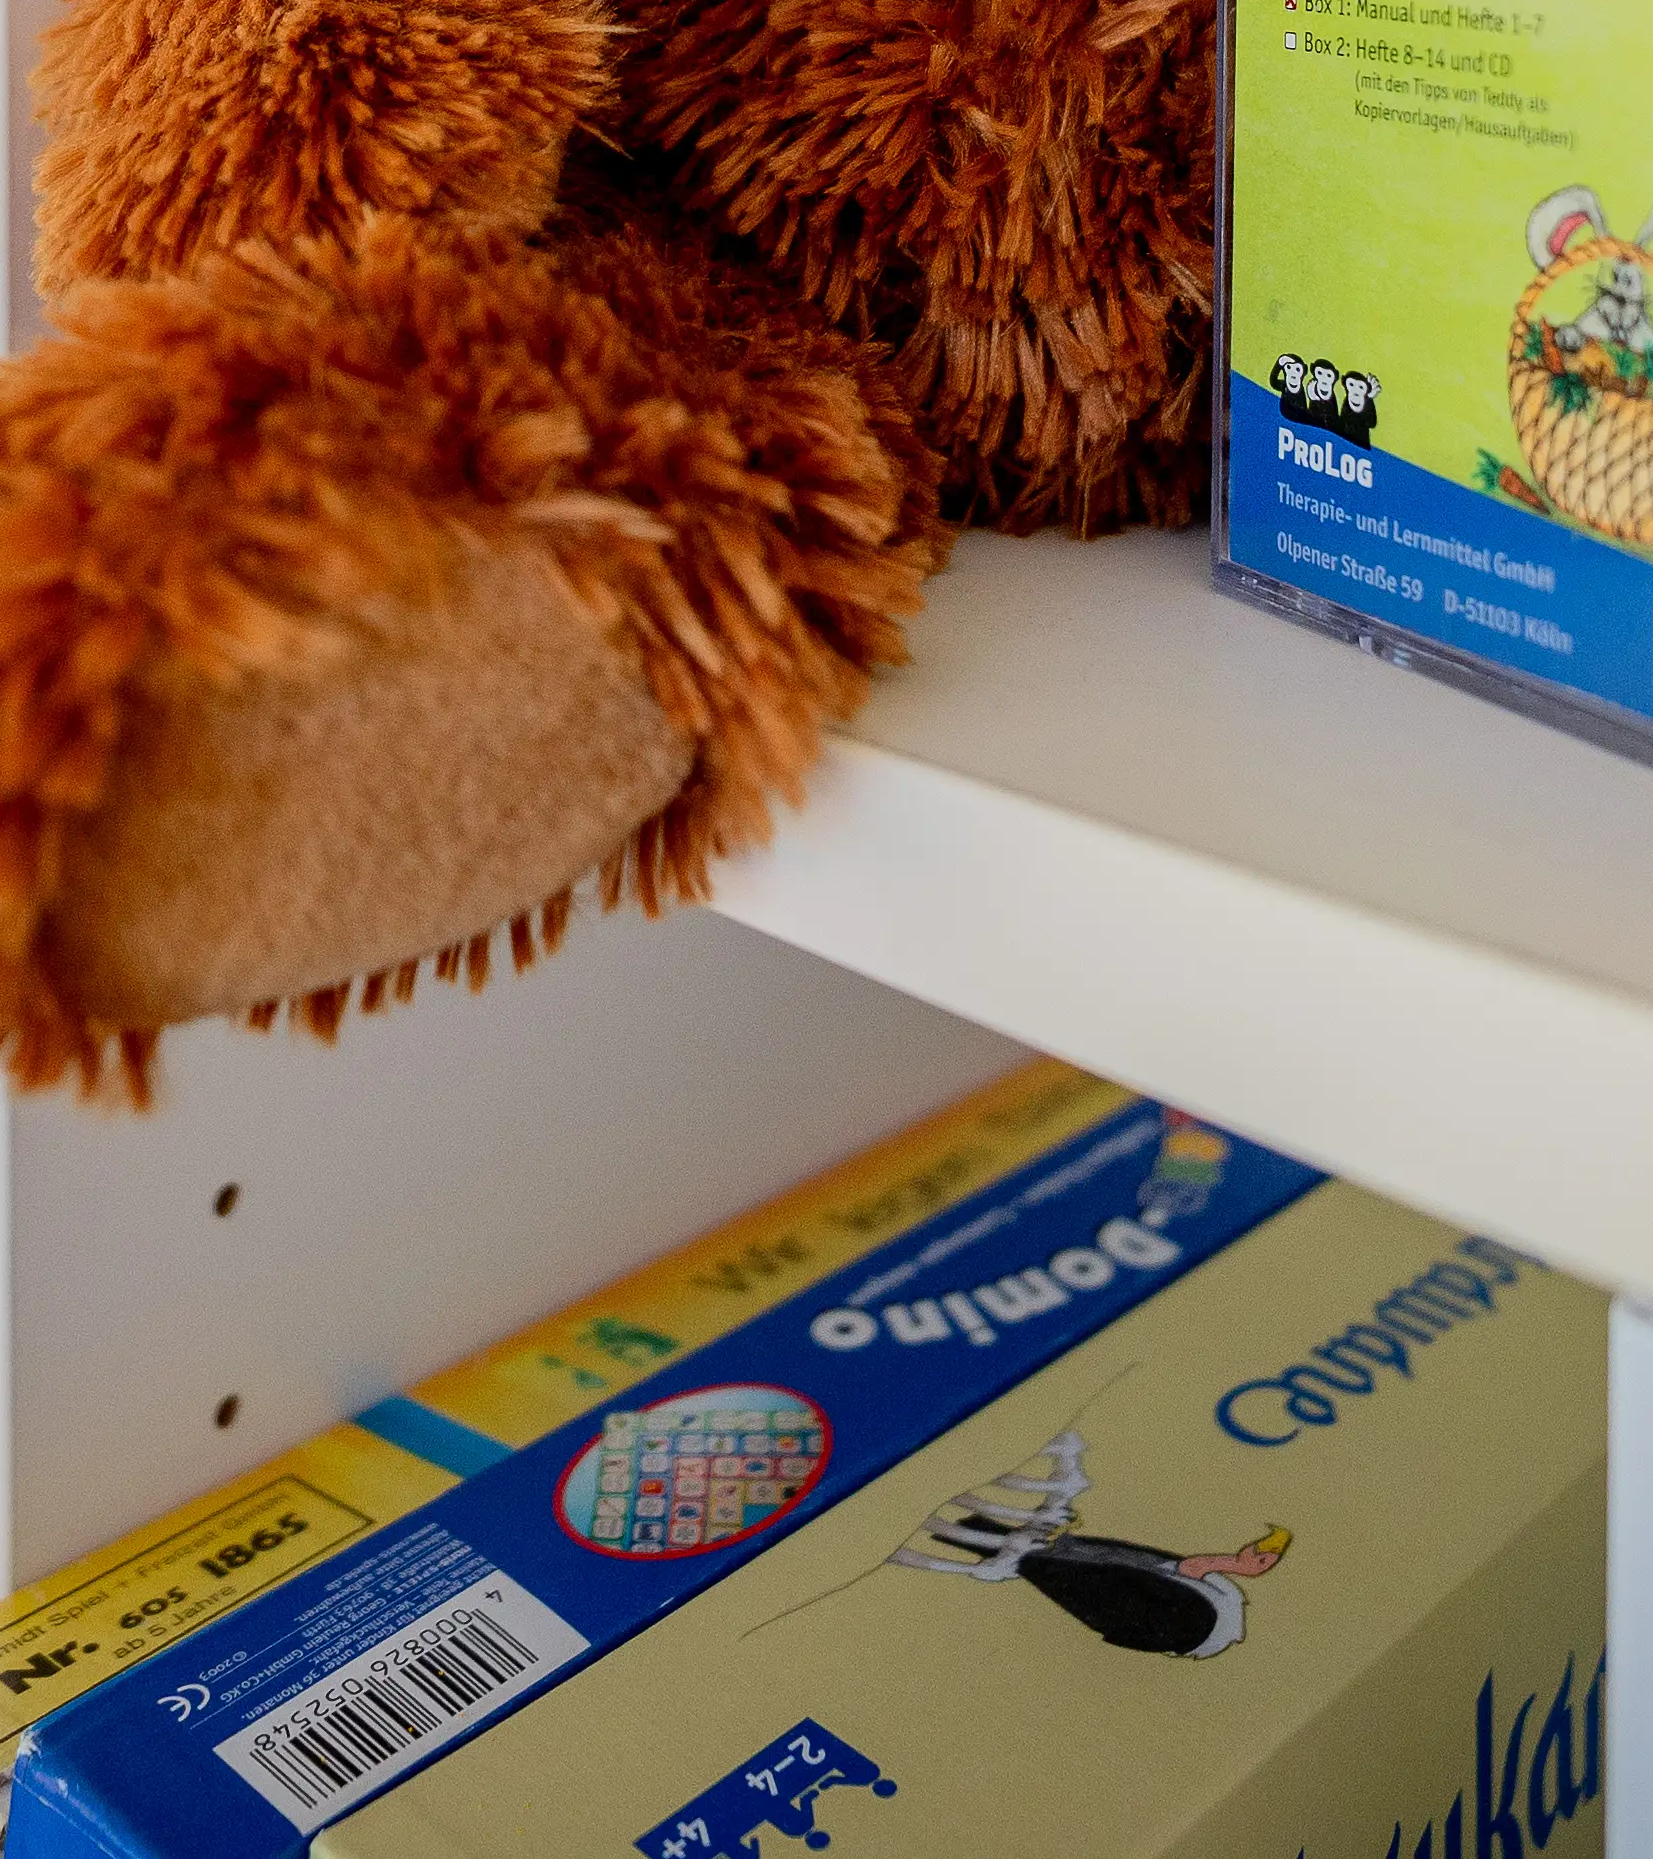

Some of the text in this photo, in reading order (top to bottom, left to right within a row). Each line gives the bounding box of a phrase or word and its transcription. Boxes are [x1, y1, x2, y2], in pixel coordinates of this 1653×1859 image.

[1420, 4, 1451, 28] und
[1457, 6, 1505, 35] Hefte
[1304, 31, 1332, 56] Box
[1336, 36, 1351, 58] 2:
[1356, 38, 1399, 64] Hefte
[1450, 52, 1485, 76] und
[1488, 53, 1513, 78] CD
[1354, 69, 1382, 93] (mit
[1385, 72, 1410, 94] den
[1413, 77, 1449, 102] Tipps
[1452, 87, 1478, 105] von
[1277, 481, 1556, 595] Therapie- und Lernmittel GmbH
[1277, 530, 1338, 573] Olpener
[1341, 555, 1398, 594] Straße
[1400, 575, 1424, 603] 59
[810, 1215, 1183, 1351] Domino
[117, 1587, 189, 1630] 605
[197, 1512, 310, 1578] 1865
[372, 1555, 403, 1577] bitte
[43, 1589, 114, 1629] Spiel
[292, 1571, 377, 1626] aufbewahren.
[332, 1588, 376, 1618] 90763
[345, 1594, 388, 1623] Georg
[107, 1634, 149, 1660] ab
[163, 1583, 239, 1627] Jahre
[299, 1613, 338, 1639] Fürth
[301, 1618, 351, 1651] Reulein
[306, 1597, 415, 1668] Verschluckgefahr.
[350, 1623, 397, 1654] Kinder
[393, 1611, 416, 1627] für
[250, 1586, 507, 1754] 4 000826 052548
[299, 1668, 322, 1685] 36
[319, 1648, 357, 1673] unter
[239, 1680, 305, 1724] Monaten.
[660, 1817, 712, 1859] 4+
